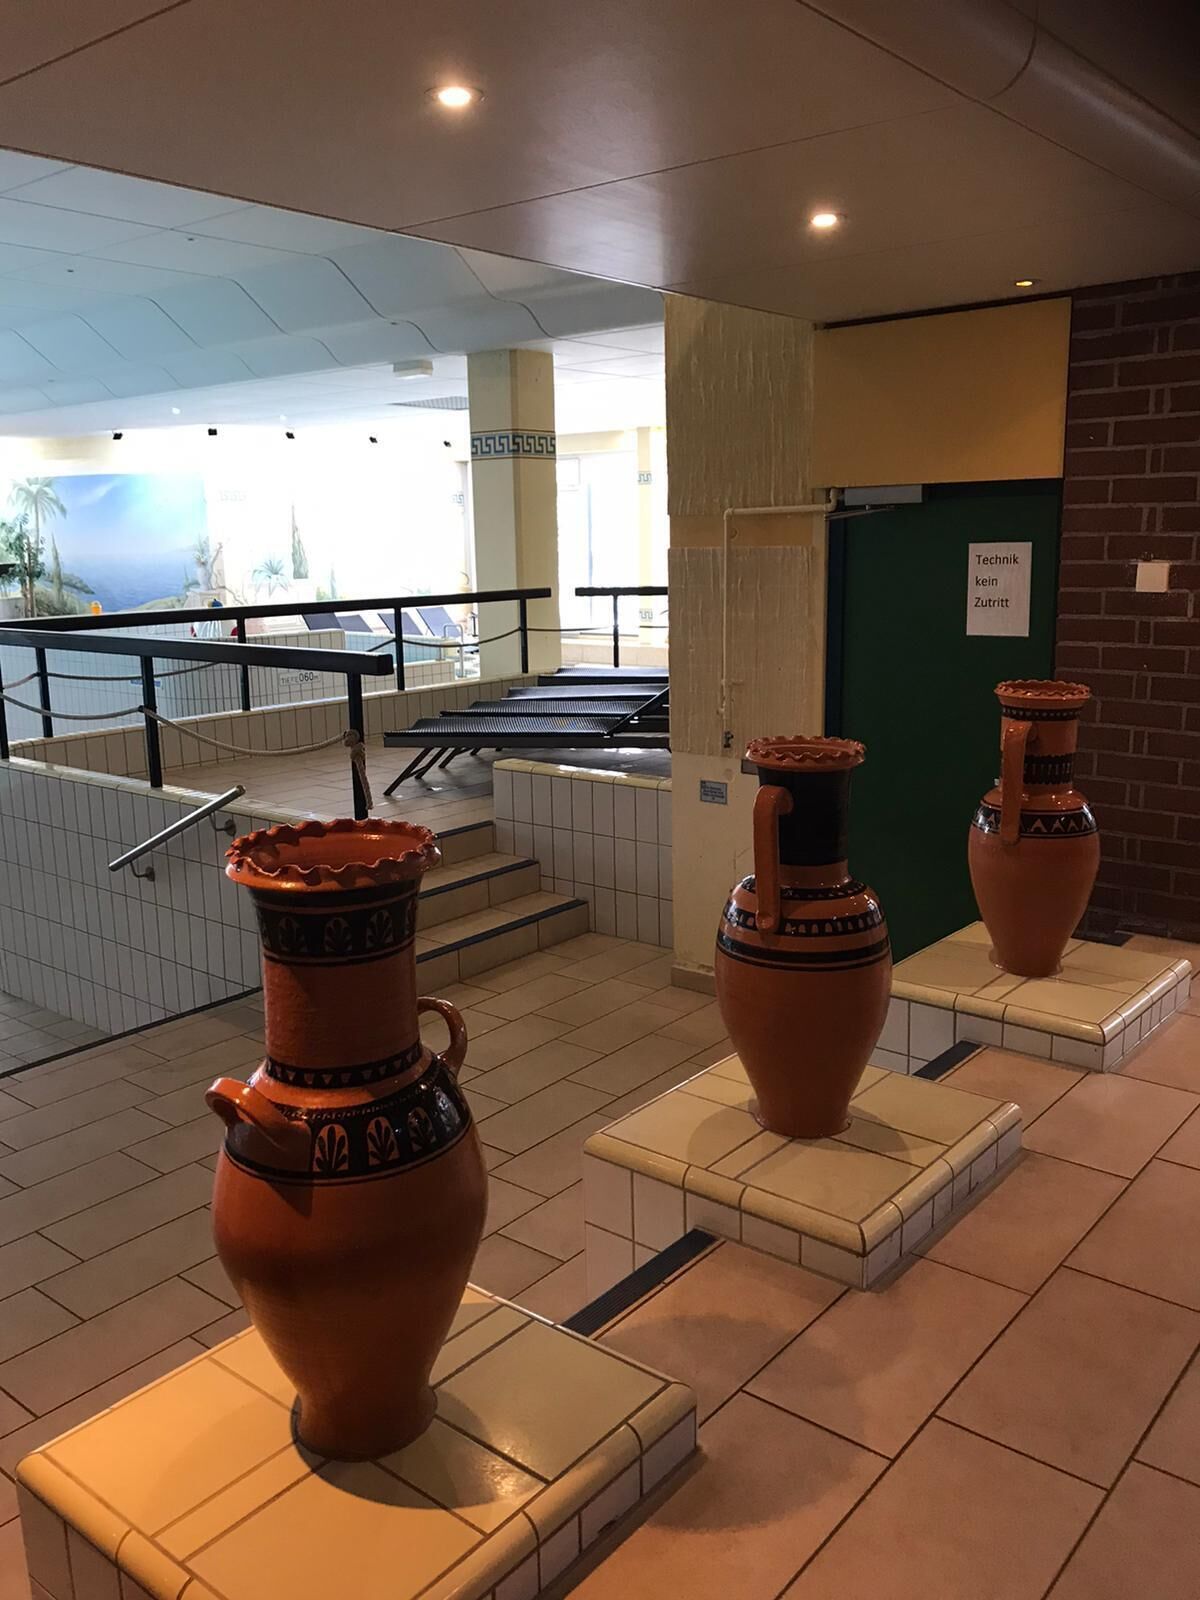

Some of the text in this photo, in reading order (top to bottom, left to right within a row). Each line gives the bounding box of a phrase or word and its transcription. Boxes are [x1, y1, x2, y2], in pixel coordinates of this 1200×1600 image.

[976, 554, 1019, 565] Technik
[975, 576, 998, 586] kein
[974, 597, 1009, 608] Zutritt
